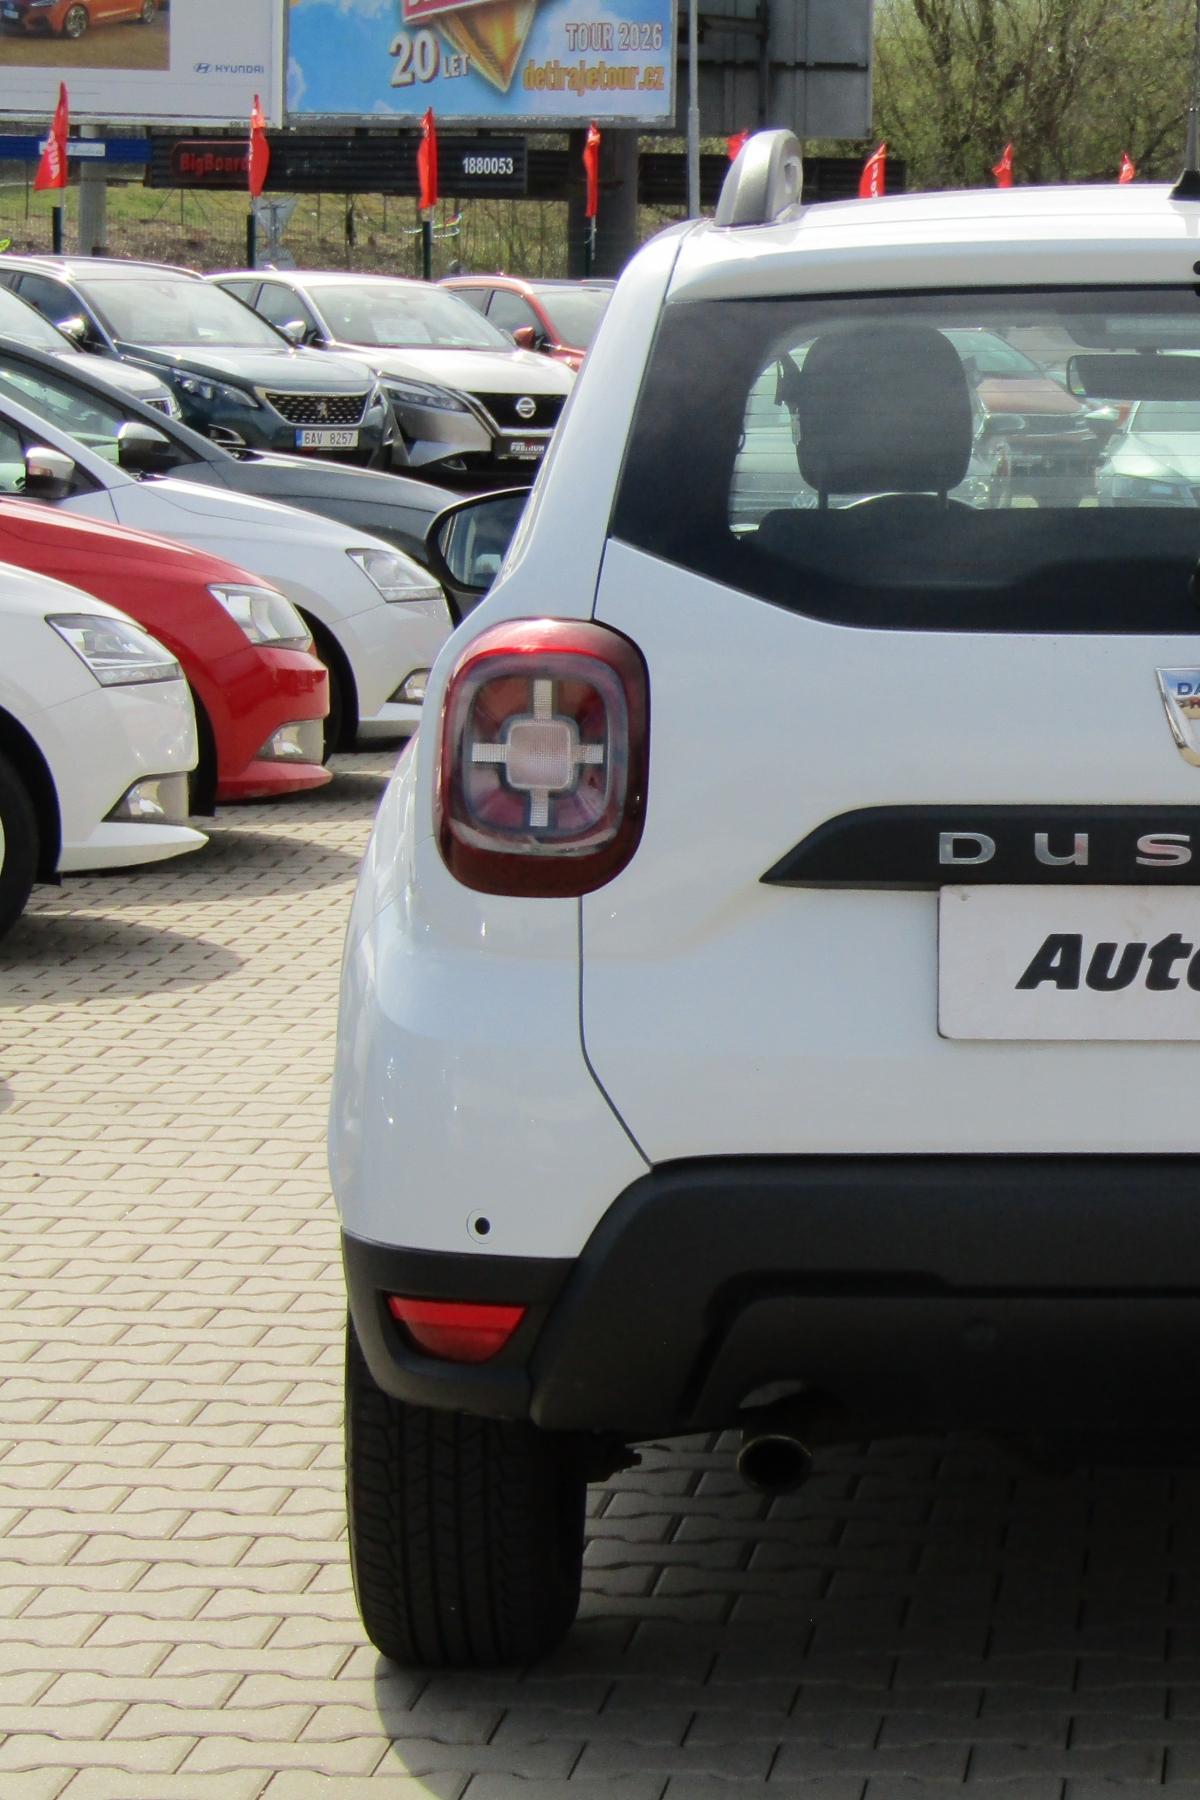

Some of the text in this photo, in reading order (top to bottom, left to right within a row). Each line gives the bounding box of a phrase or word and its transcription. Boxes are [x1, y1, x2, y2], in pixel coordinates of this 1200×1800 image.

[565, 23, 663, 51] TOUR 2026
[215, 64, 265, 73] HYUNDAI
[389, 30, 440, 88] 20
[443, 54, 471, 79] LET
[523, 60, 665, 96] detirajetour.cz
[462, 157, 514, 175] 1880053
[304, 432, 353, 445] 6AV 8257
